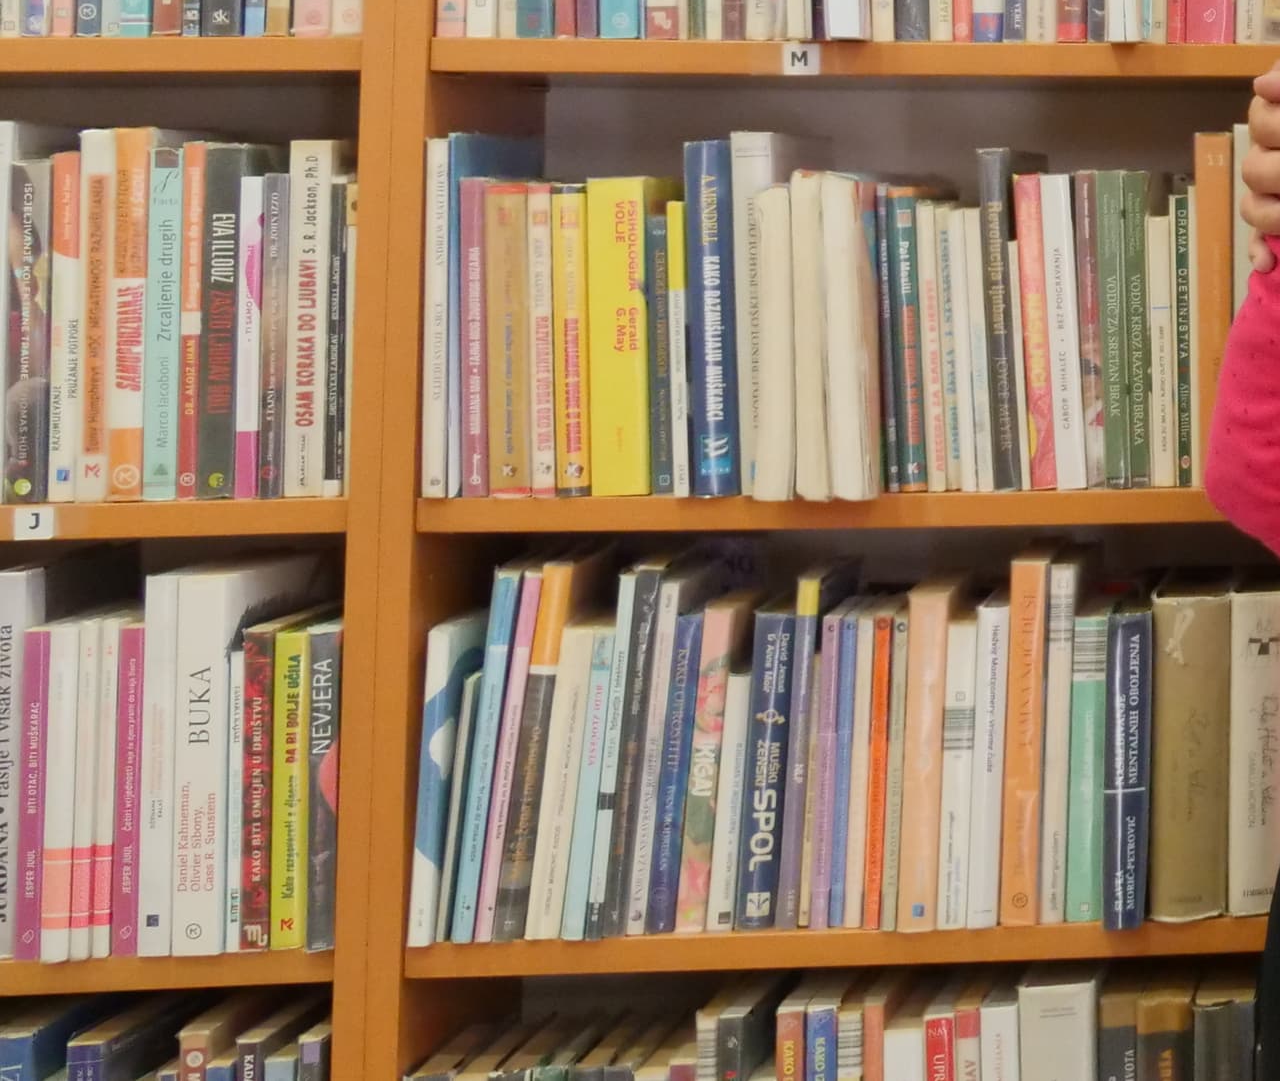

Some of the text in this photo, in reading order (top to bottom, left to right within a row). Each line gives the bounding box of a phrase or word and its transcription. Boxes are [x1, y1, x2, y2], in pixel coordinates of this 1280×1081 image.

[791, 51, 808, 66] M
[156, 219, 177, 266] drugih
[615, 202, 625, 243] VOLJE
[1177, 210, 1187, 253] DRAMA
[628, 200, 639, 291] PSIHOLOGIJA
[298, 260, 317, 308] LJUBAVI
[703, 256, 720, 285] KAKO
[156, 271, 175, 341] Zrcaljenje
[299, 313, 316, 331] DO
[1108, 318, 1119, 333] ZA
[614, 307, 626, 352] G. May
[629, 307, 639, 350] Gerald
[1131, 317, 1142, 349] KROZ
[297, 336, 315, 386] KORAKA
[1108, 336, 1120, 381] SRETAN
[1132, 352, 1144, 401] RAZVOD
[296, 391, 314, 427] OSAM
[1109, 384, 1120, 416] BRAK
[155, 410, 168, 448] Marco
[1133, 404, 1145, 445] BRAKA
[30, 513, 40, 529] J
[187, 666, 212, 745] BUKA
[311, 659, 333, 754] NEVJERA
[29, 752, 39, 767] BITI
[28, 798, 38, 813] BITI
[249, 697, 264, 881] KAKO BITI OMILJEN U DRUŠTVU
[177, 781, 191, 892] Daniel Kahneman,
[204, 793, 217, 892] Cass R. Sunstein
[749, 790, 776, 871] SPOL
[24, 870, 36, 898] JESPER
[190, 854, 202, 892] Olivier
